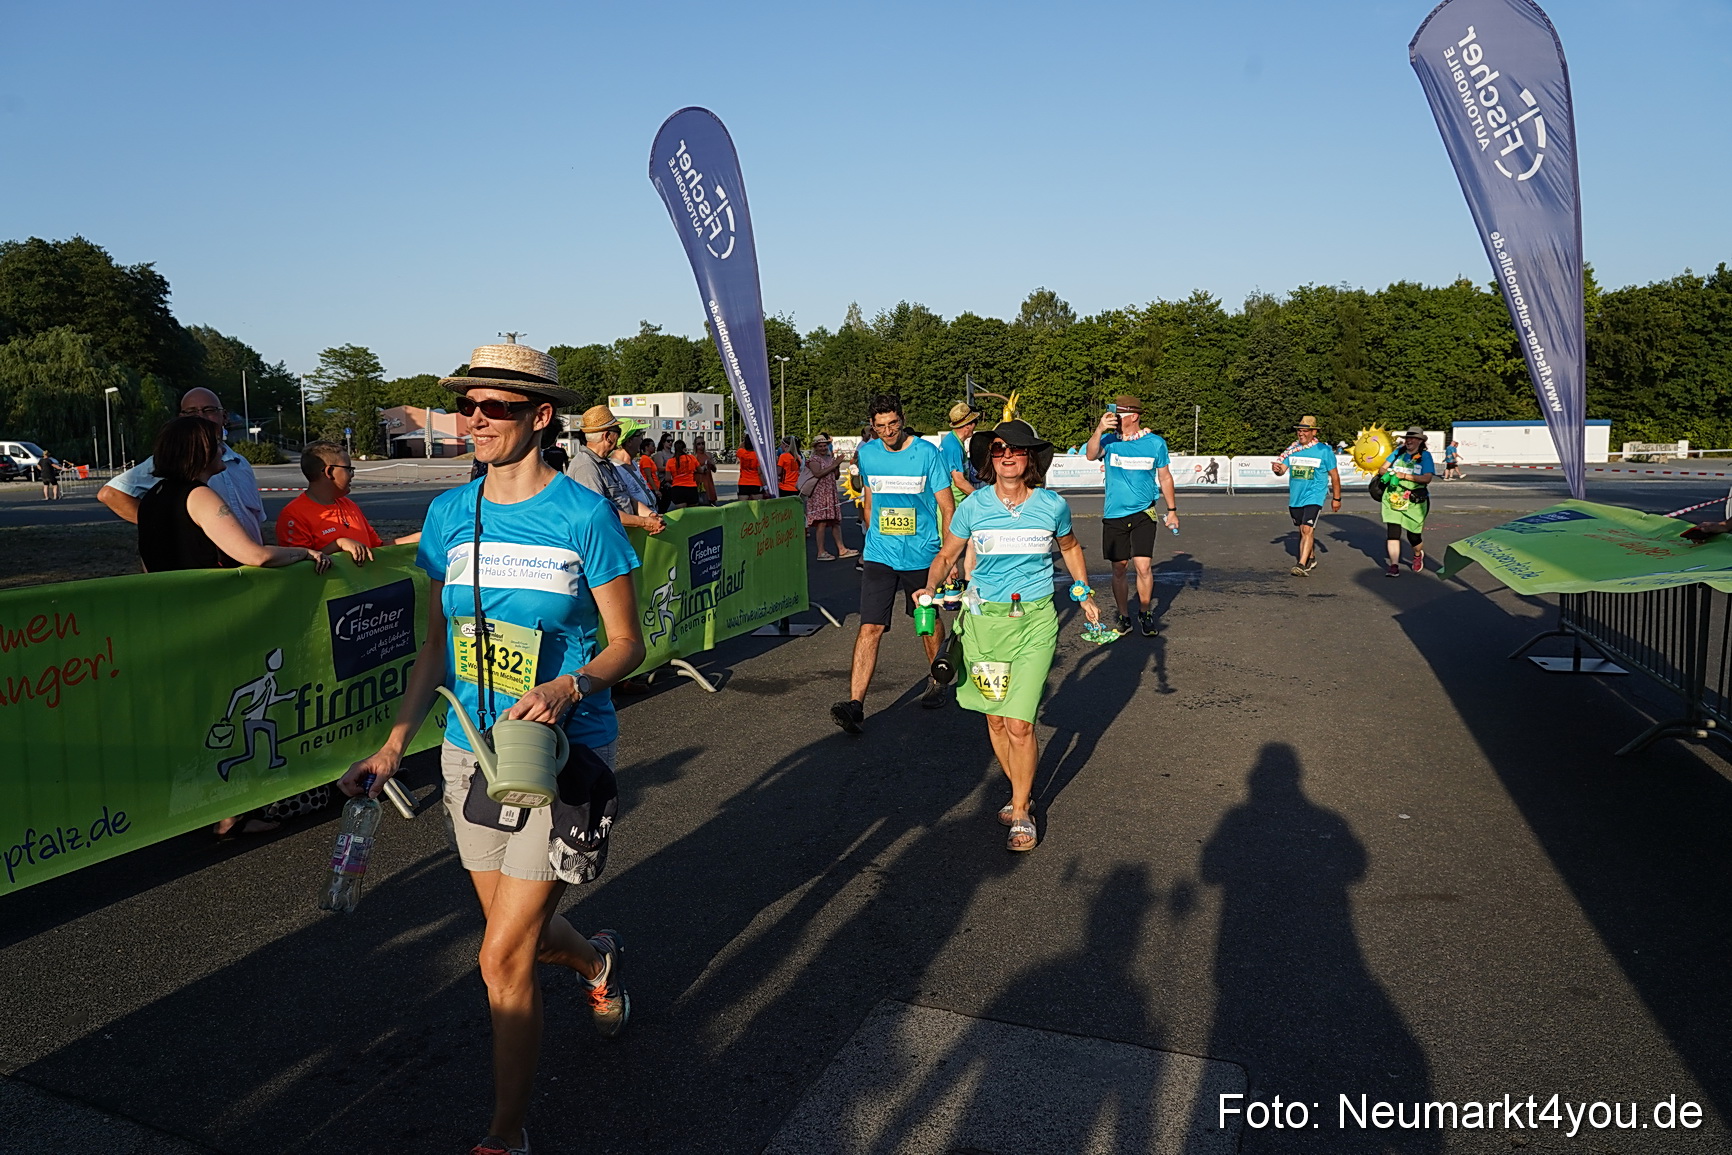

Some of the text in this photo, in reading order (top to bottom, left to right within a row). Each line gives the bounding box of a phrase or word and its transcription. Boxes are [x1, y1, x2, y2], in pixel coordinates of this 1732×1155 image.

[885, 517, 910, 527] 1433
[485, 567, 506, 577] Haus
[508, 567, 518, 578] St.
[520, 569, 553, 581] Marien
[349, 604, 404, 635] Fischer
[356, 620, 399, 642] AUTOMOBILE
[459, 640, 468, 673] WALK
[523, 658, 533, 691] 2022
[976, 675, 1009, 689] 1443
[300, 704, 391, 755] neumarkt
